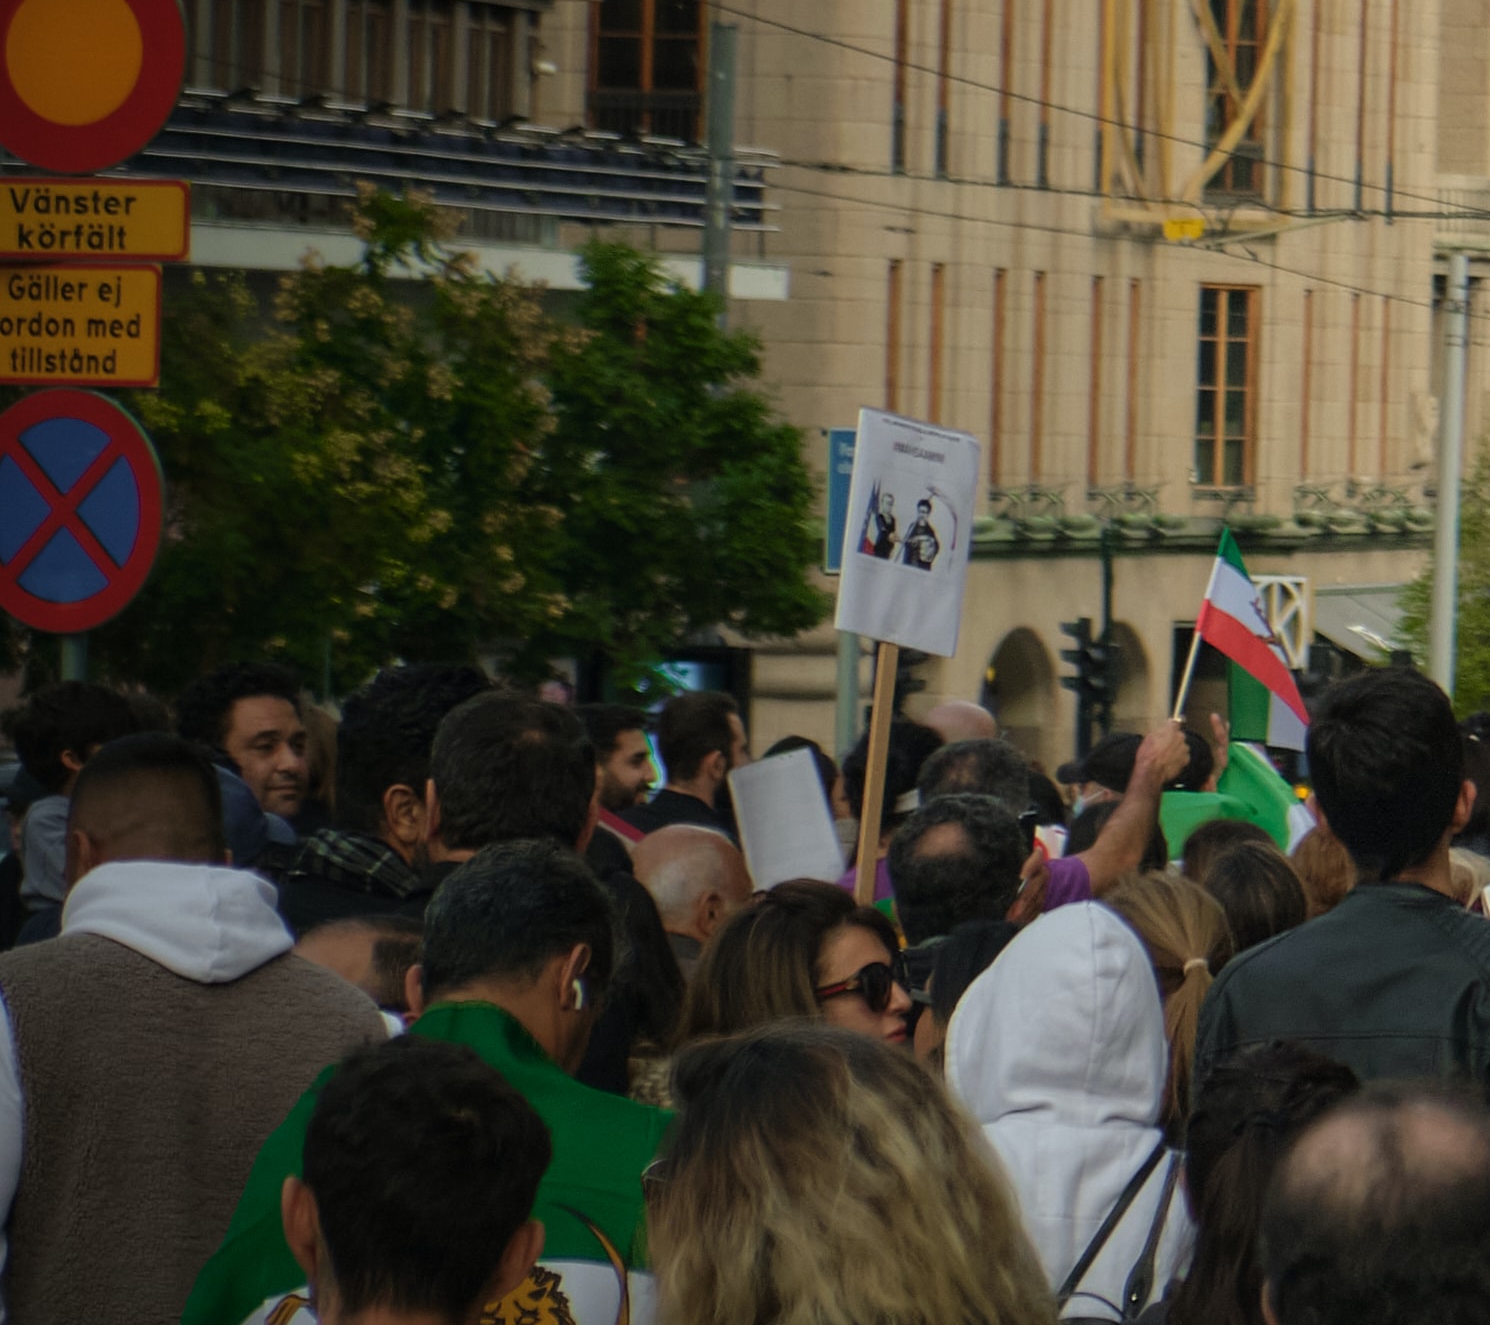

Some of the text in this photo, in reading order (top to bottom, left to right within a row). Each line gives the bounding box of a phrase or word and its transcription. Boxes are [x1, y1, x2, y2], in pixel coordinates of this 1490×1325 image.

[9, 187, 137, 216] Vänster
[17, 222, 128, 251] körfält
[8, 273, 122, 308] Gäller ej
[0, 311, 141, 339] ordon med
[10, 347, 118, 375] tillstånd
